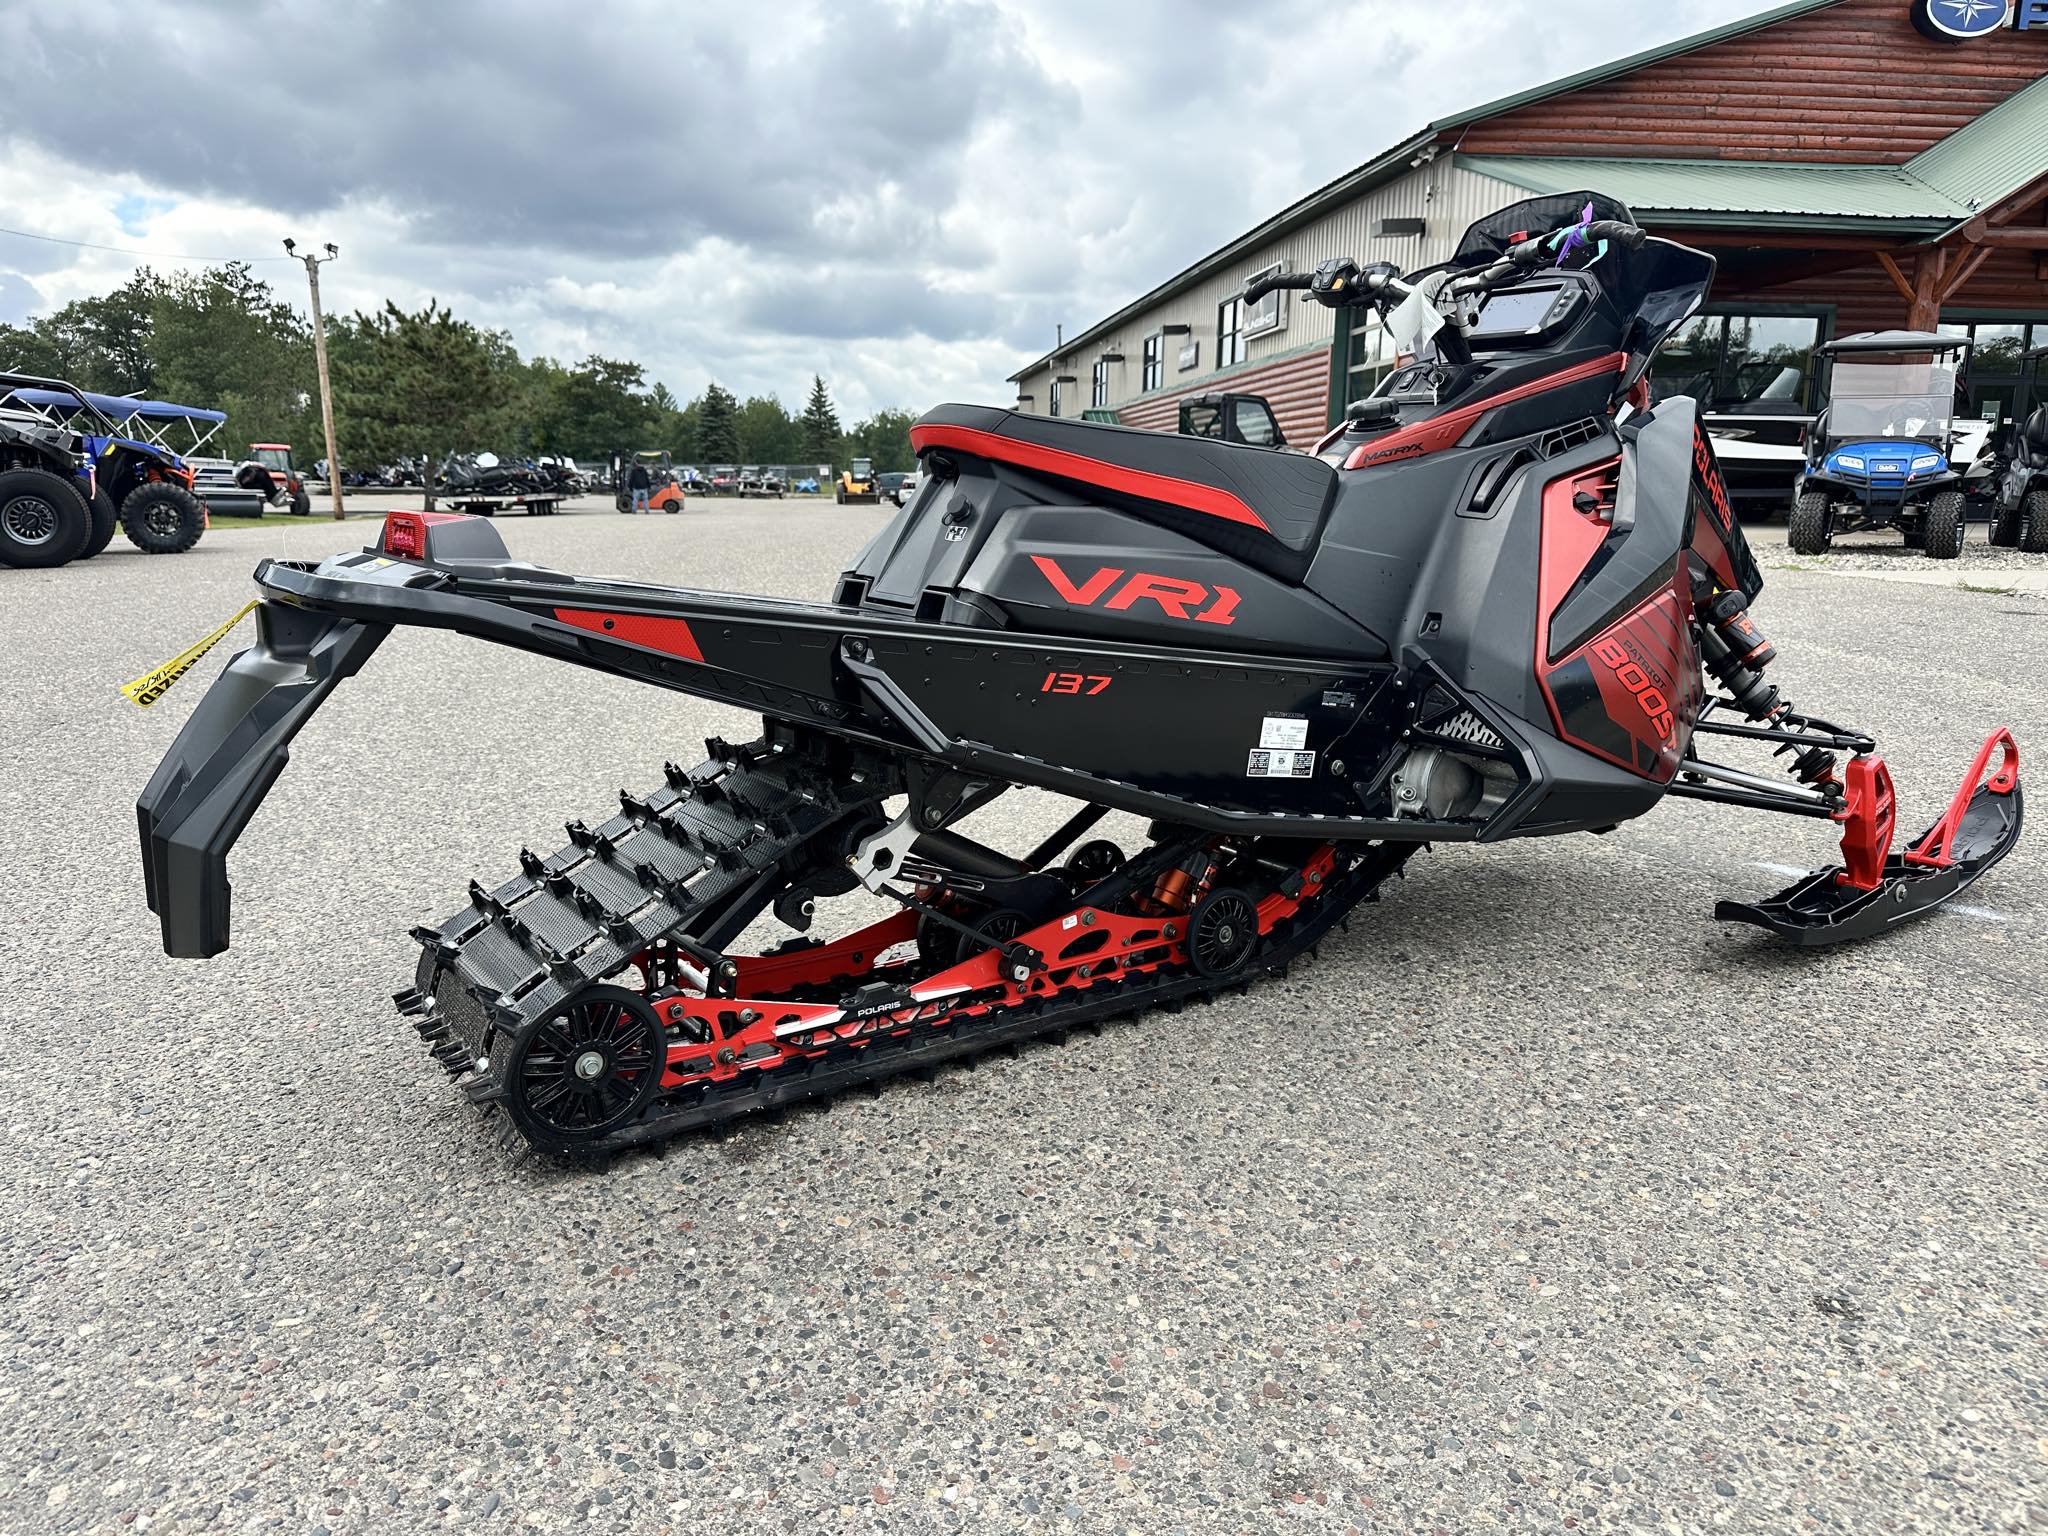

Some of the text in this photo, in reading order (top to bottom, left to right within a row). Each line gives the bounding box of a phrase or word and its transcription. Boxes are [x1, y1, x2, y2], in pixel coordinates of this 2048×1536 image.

[1363, 442, 1425, 464] MATRYX
[1030, 554, 1242, 625] VR1
[1623, 640, 1667, 689] PATRIOT
[1041, 672, 1113, 695] 137
[857, 1001, 902, 1017] POLARIS
